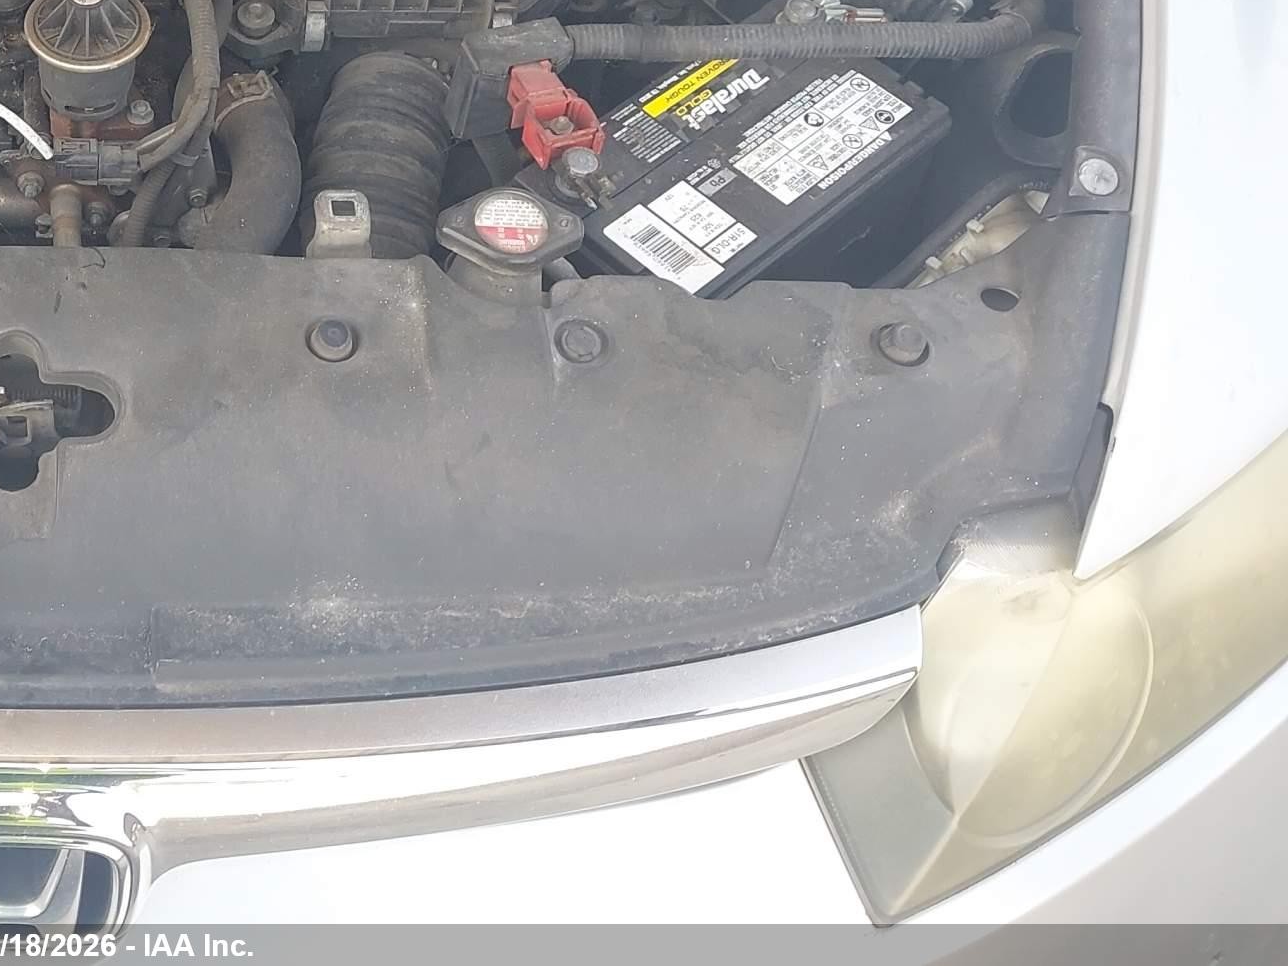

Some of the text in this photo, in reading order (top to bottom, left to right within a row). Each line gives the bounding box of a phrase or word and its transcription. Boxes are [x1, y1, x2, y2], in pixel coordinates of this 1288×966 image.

[665, 80, 697, 103] TOUGH
[676, 89, 712, 116] GOLD
[682, 68, 770, 130] Duralast
[709, 175, 726, 187] Pb
